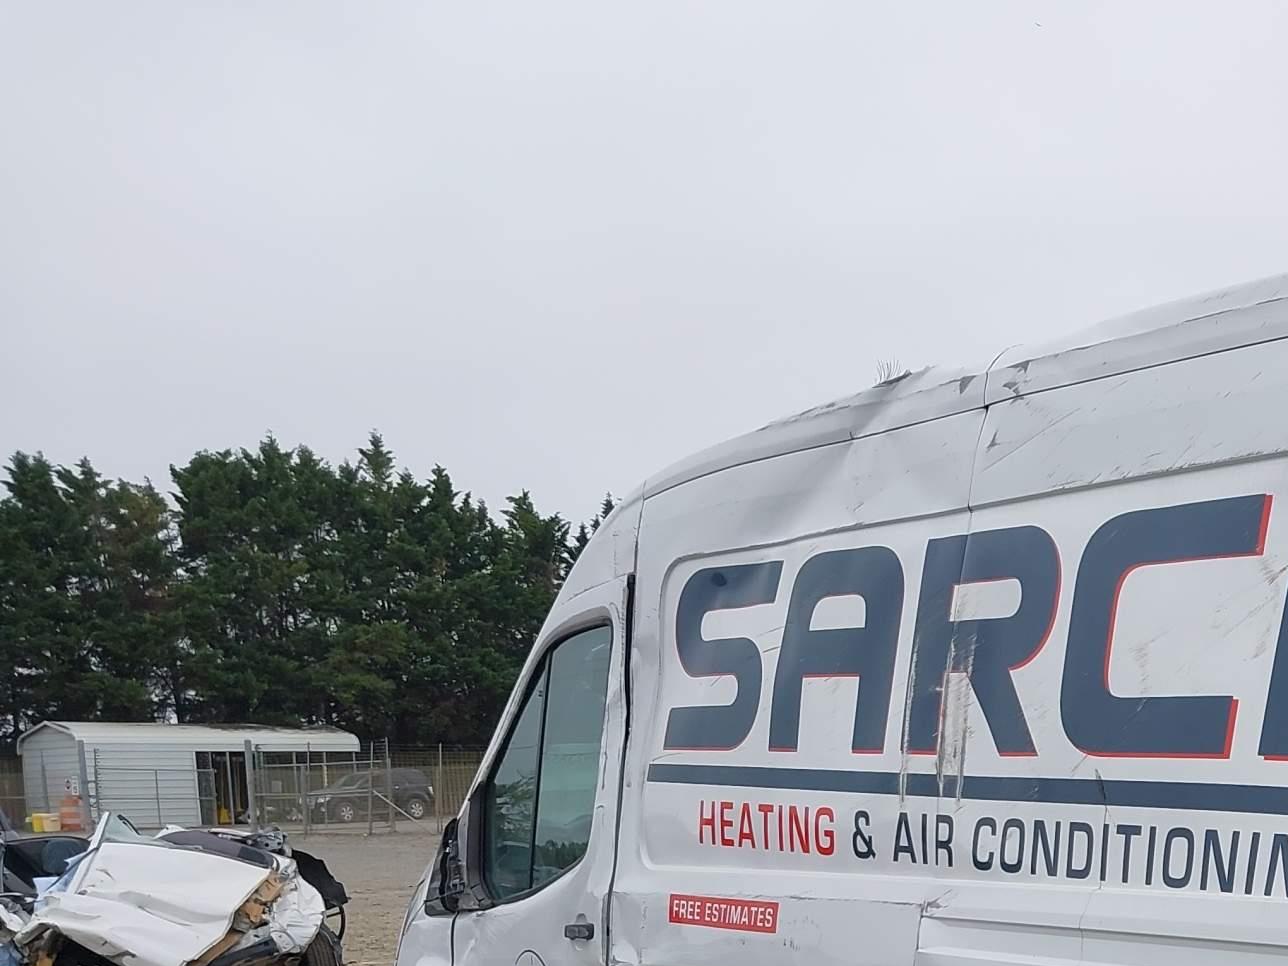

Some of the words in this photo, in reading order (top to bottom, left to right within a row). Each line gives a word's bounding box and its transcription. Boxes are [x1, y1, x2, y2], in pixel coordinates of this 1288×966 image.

[699, 800, 836, 857] HEATING
[852, 810, 876, 859] &
[892, 811, 954, 868] AIR
[672, 899, 702, 921] FREE
[705, 903, 774, 928] ESTIMATES
